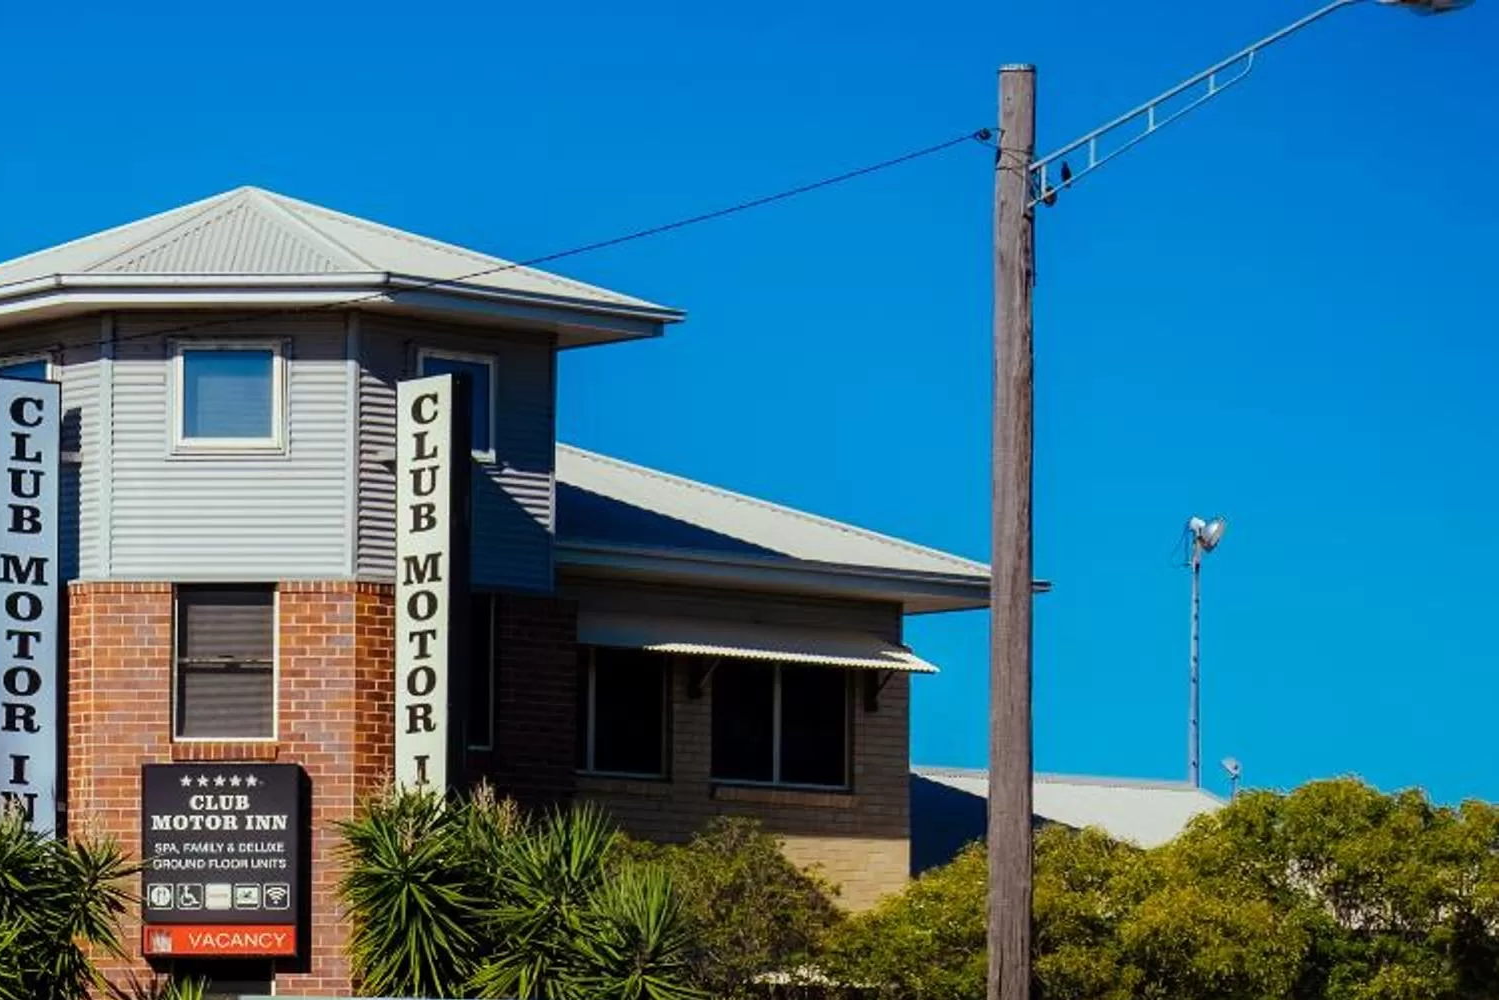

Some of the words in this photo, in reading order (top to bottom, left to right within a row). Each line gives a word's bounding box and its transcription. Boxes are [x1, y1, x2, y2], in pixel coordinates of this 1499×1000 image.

[6, 396, 45, 535] CLUB
[409, 392, 440, 533] CLUB
[0, 553, 49, 734] MOTOR
[403, 551, 443, 735] MOTOR
[189, 794, 251, 811] CLUB
[151, 815, 238, 831] MOTOR
[245, 815, 289, 831] INN
[154, 843, 180, 854] SPA,
[183, 843, 224, 853] FAMILY
[239, 843, 285, 853] DELUXE
[153, 859, 206, 870] GROUND
[208, 859, 248, 869] FLOOR
[251, 859, 287, 869] UNITS
[188, 932, 287, 949] VACANCY
